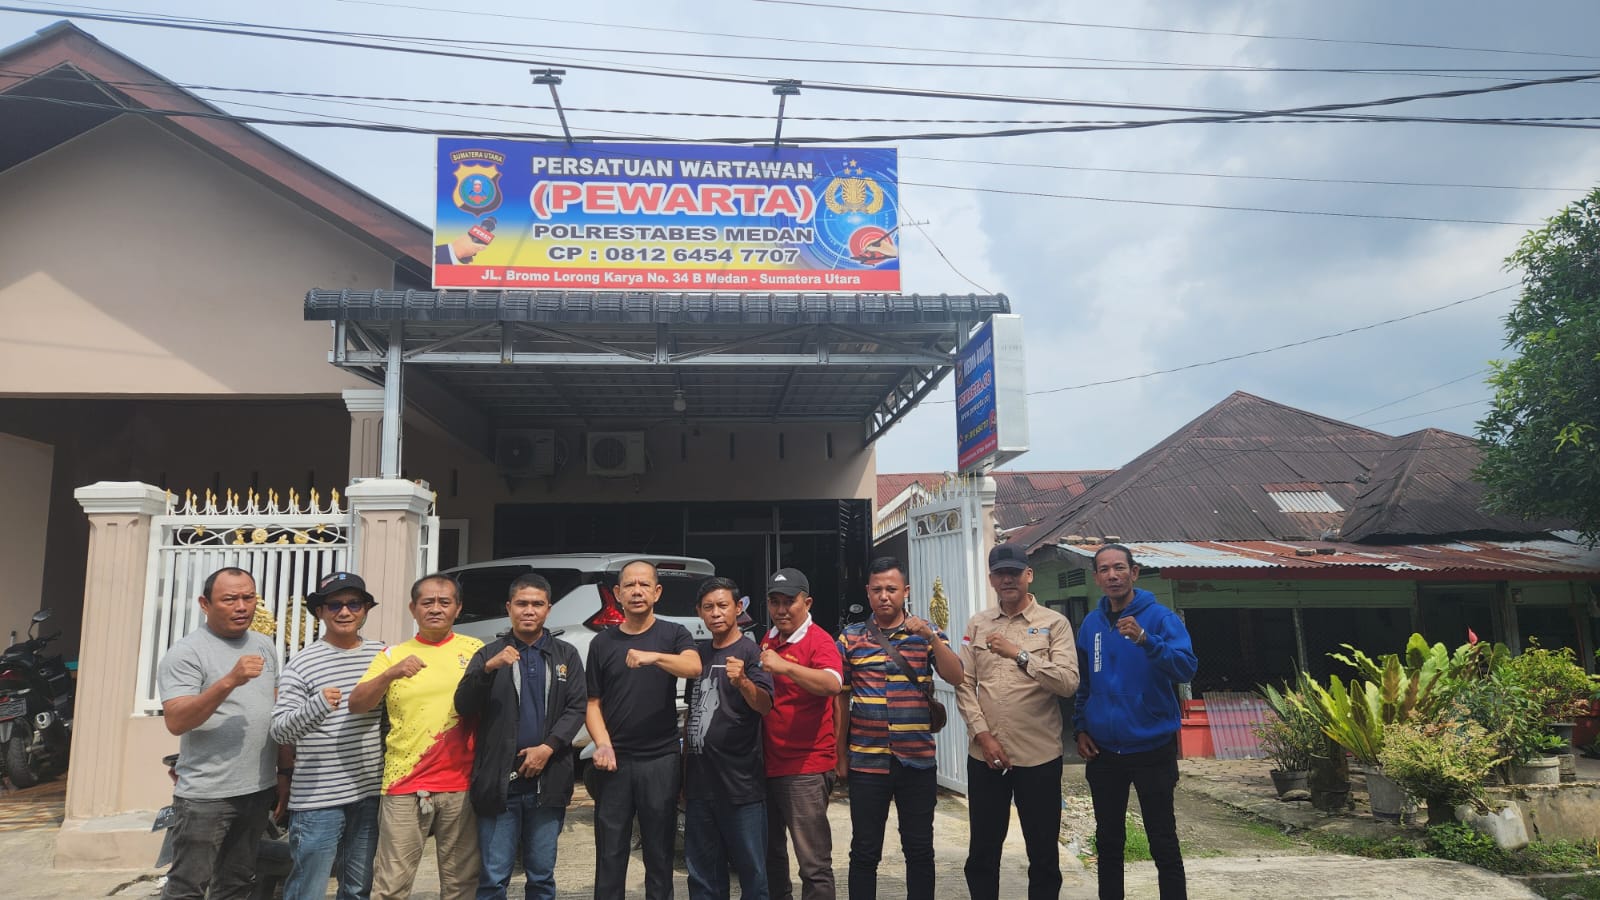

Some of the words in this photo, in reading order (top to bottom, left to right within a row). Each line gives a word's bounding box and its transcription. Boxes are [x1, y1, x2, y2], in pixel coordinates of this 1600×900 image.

[452, 151, 483, 161] SUMATERA
[483, 152, 504, 163] UTARA
[532, 156, 673, 178] PERSATUAN
[680, 160, 813, 179] WARTAWAN
[531, 182, 815, 222] (PEWARTA)
[534, 225, 717, 241] POLRESTABES
[725, 228, 813, 242] MEDAN
[549, 247, 582, 260] CP
[605, 247, 665, 261] 0812
[673, 248, 733, 262] 6454
[740, 249, 798, 262] 7707
[481, 270, 501, 281] JL.
[506, 271, 550, 282] Bromo
[554, 271, 600, 284] Lorong
[604, 272, 643, 285] Karya
[647, 272, 669, 283] No.
[673, 273, 689, 283] 34
[693, 273, 702, 283] B
[706, 273, 748, 284] Medan
[760, 273, 821, 284] Sumatera
[825, 273, 861, 284] Utara
